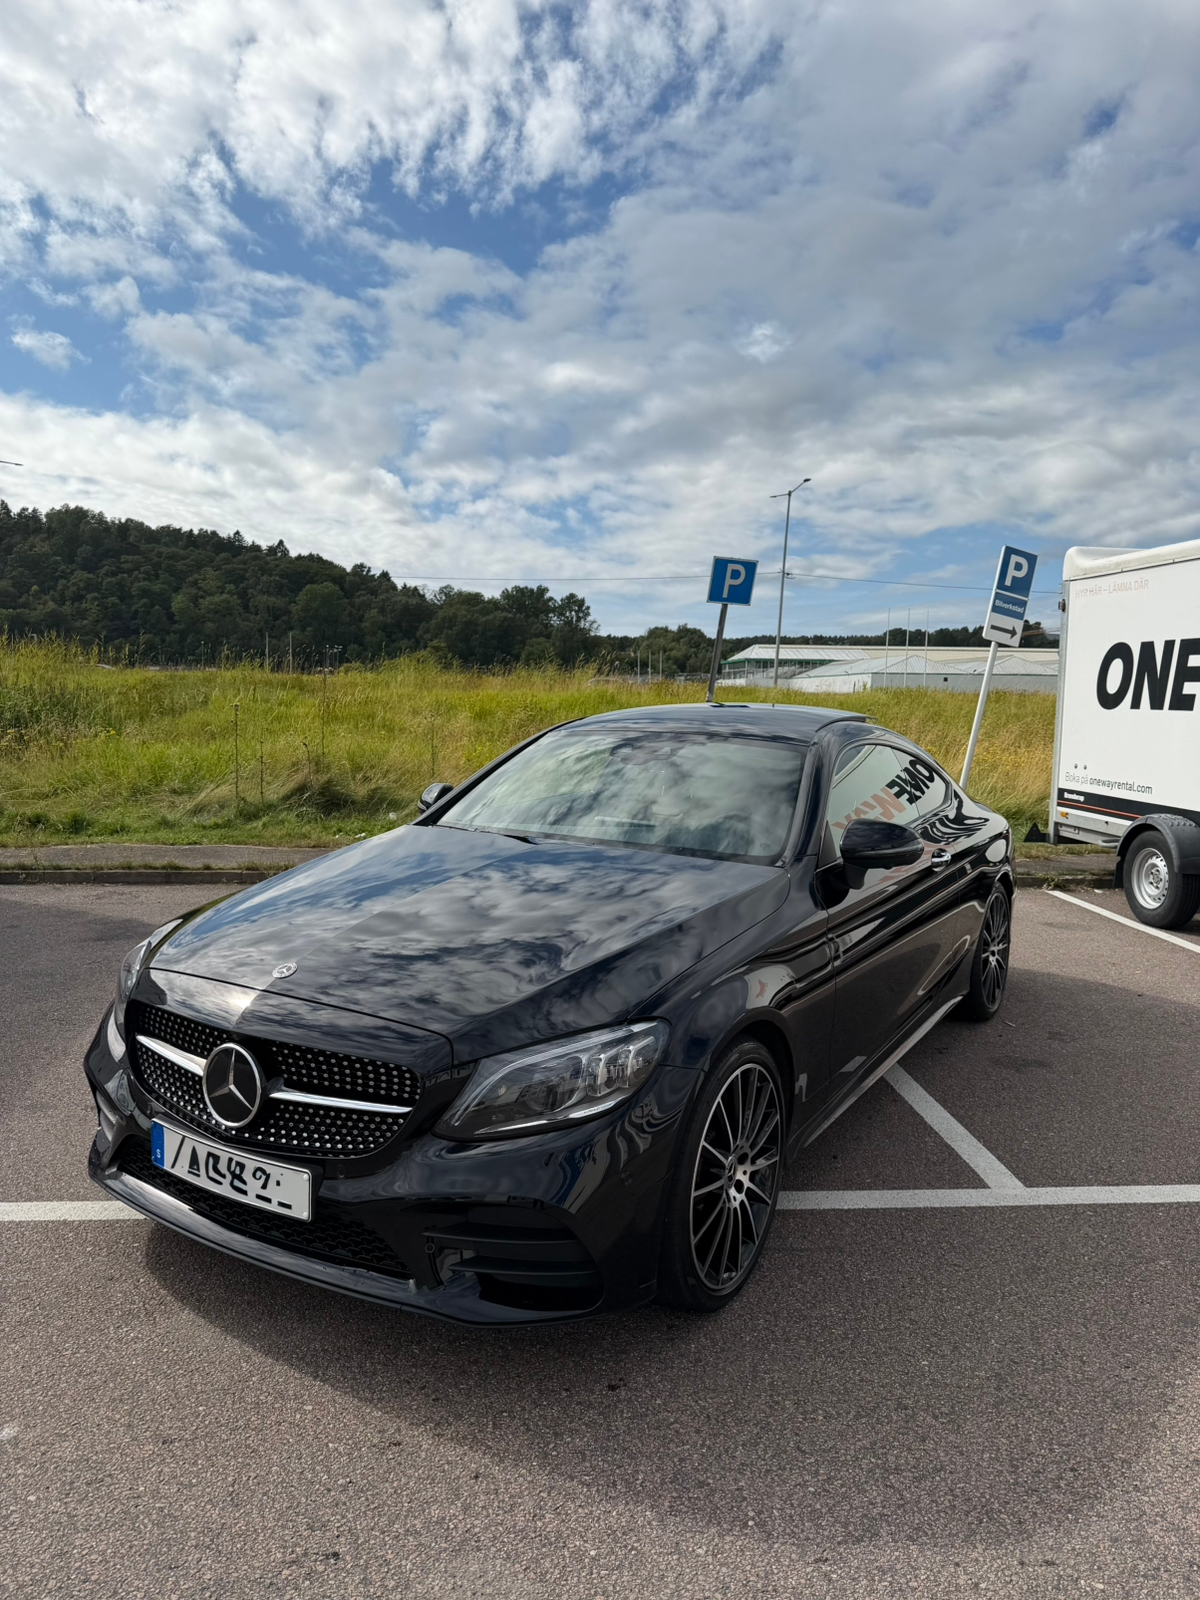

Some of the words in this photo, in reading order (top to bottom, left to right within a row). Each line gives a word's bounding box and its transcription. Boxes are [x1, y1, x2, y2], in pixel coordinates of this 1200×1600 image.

[722, 563, 746, 598] P
[1004, 554, 1029, 587] P
[1108, 581, 1133, 594] LÄMNA
[1134, 577, 1149, 591] DÄR
[994, 599, 1025, 613] Bilverkstad
[1096, 638, 1200, 711] ONE
[1065, 772, 1080, 783] Boka
[1080, 774, 1089, 786] på
[1089, 777, 1153, 794] onewayrental.com
